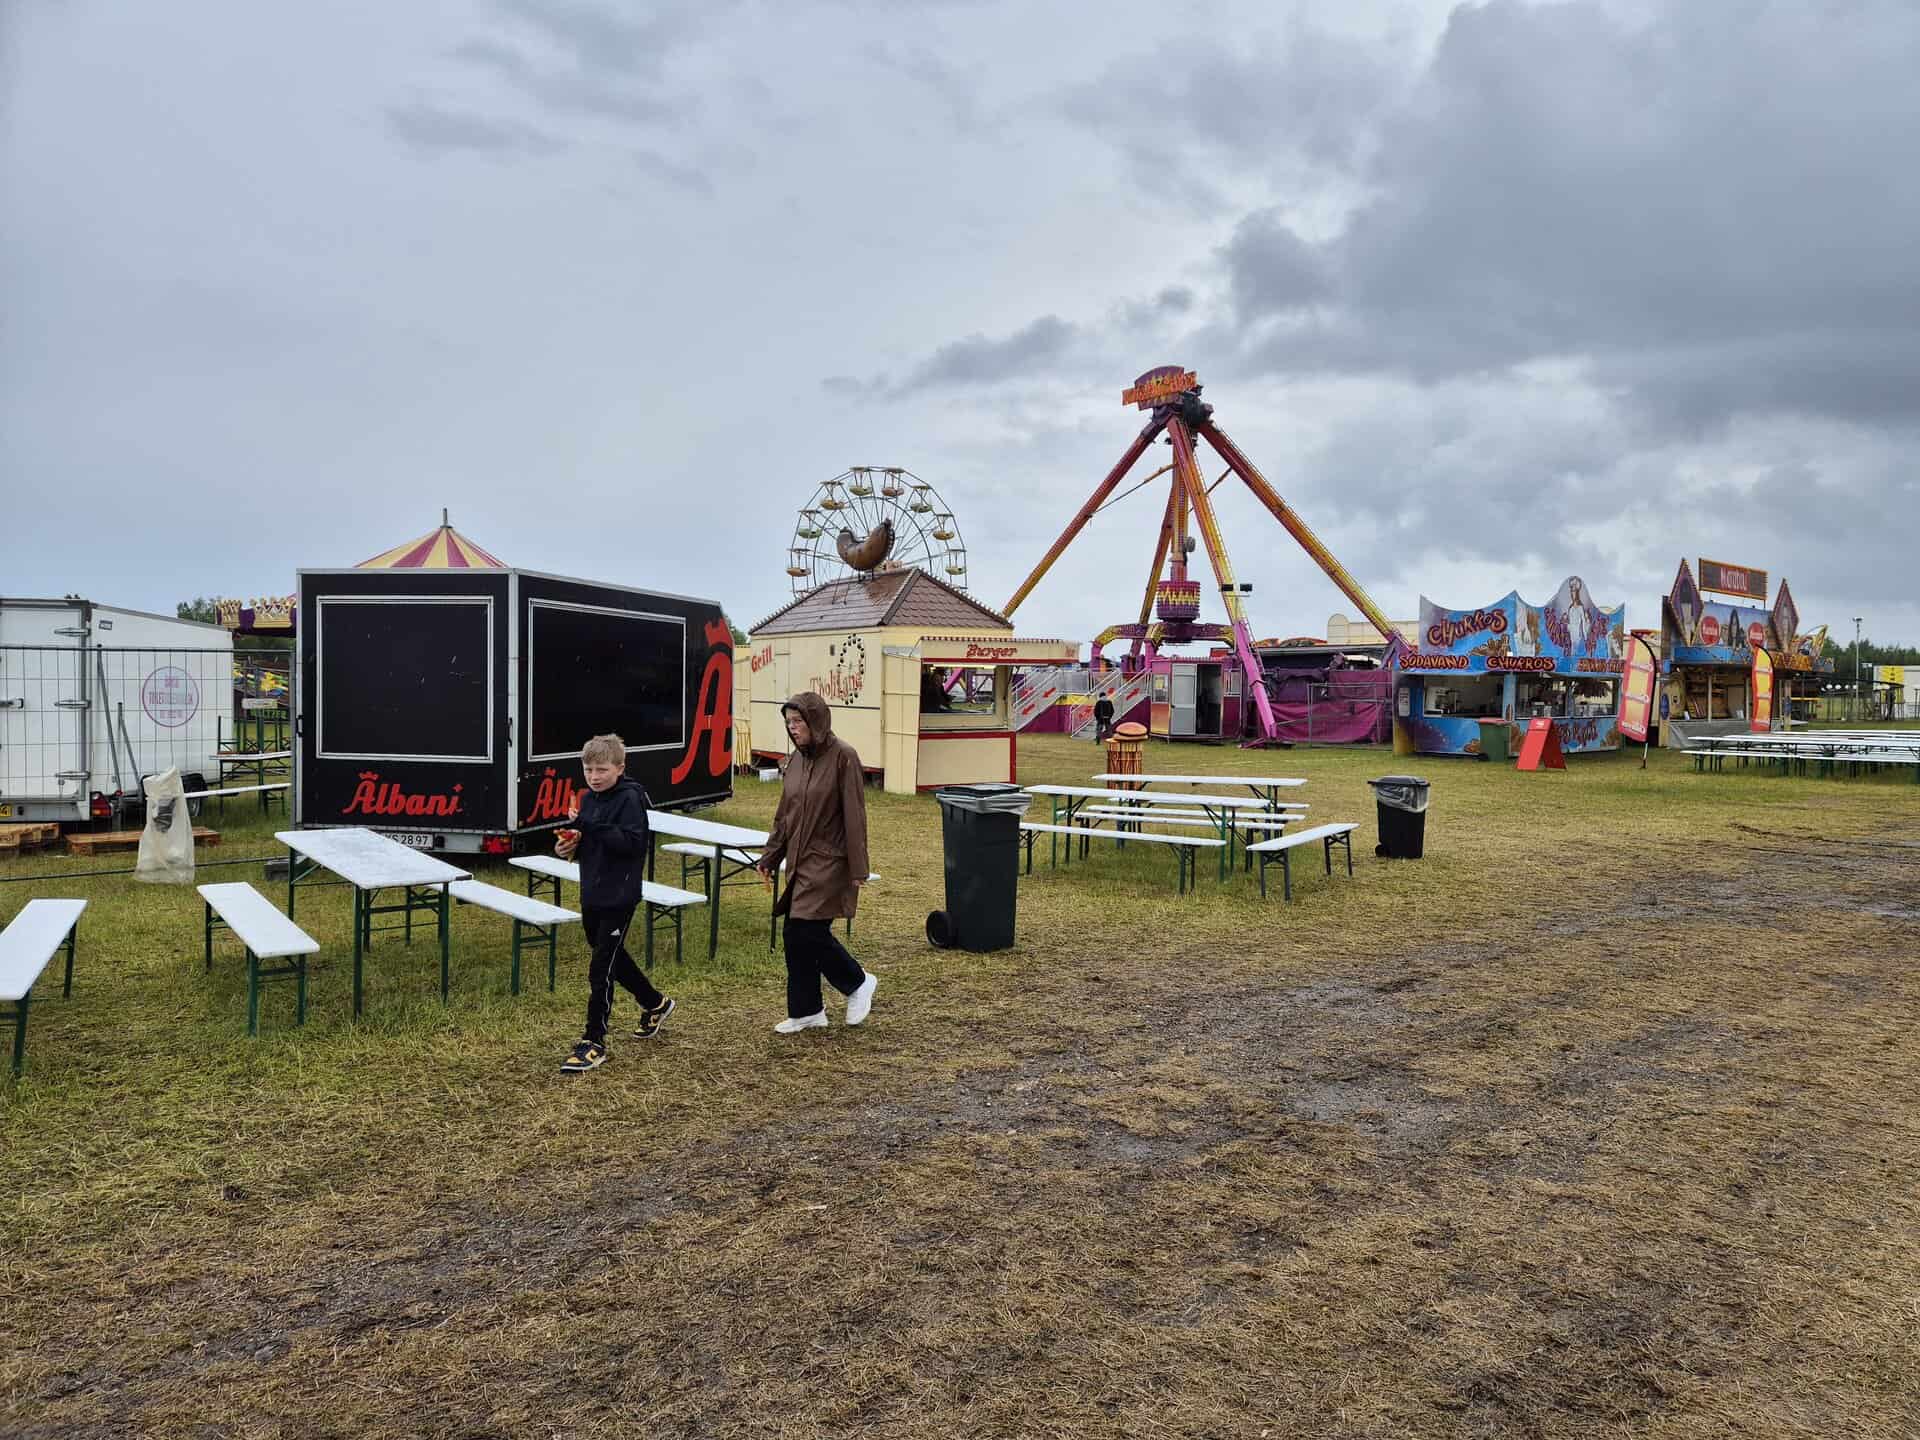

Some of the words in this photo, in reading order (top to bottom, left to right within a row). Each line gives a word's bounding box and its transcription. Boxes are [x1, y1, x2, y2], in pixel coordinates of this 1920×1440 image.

[1428, 609, 1508, 648] CHURROS
[966, 644, 1017, 658] Burger
[751, 645, 772, 673] Grill
[1399, 655, 1470, 670] SODAVAND
[1487, 656, 1555, 671] CHURROS
[400, 834, 414, 846] 28
[415, 835, 428, 846] 97
